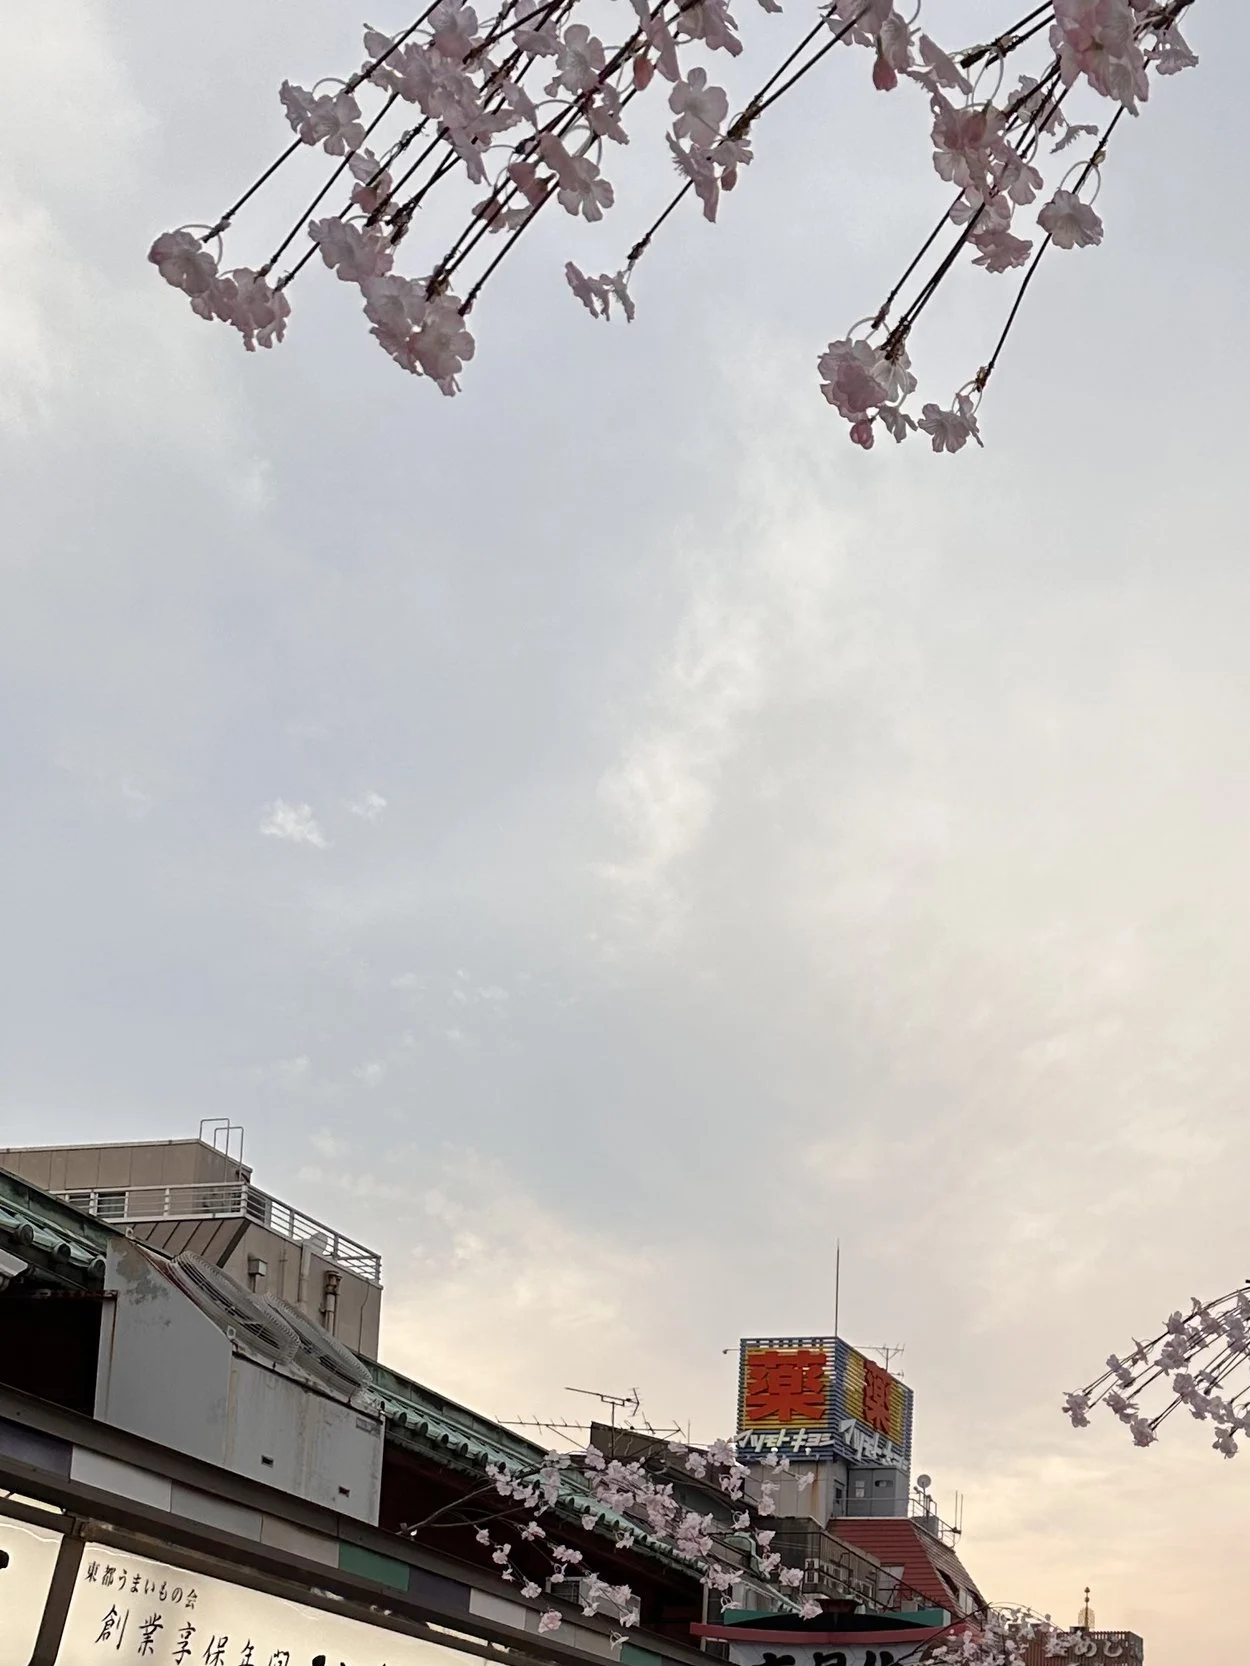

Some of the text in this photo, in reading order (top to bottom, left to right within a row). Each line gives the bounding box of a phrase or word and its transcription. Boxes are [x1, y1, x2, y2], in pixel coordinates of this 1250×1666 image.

[745, 1350, 827, 1422] 薬
[861, 1360, 893, 1435] 薬
[733, 1428, 835, 1452] マツモトキヨシ
[85, 1560, 198, 1610] 東都うまいもの会
